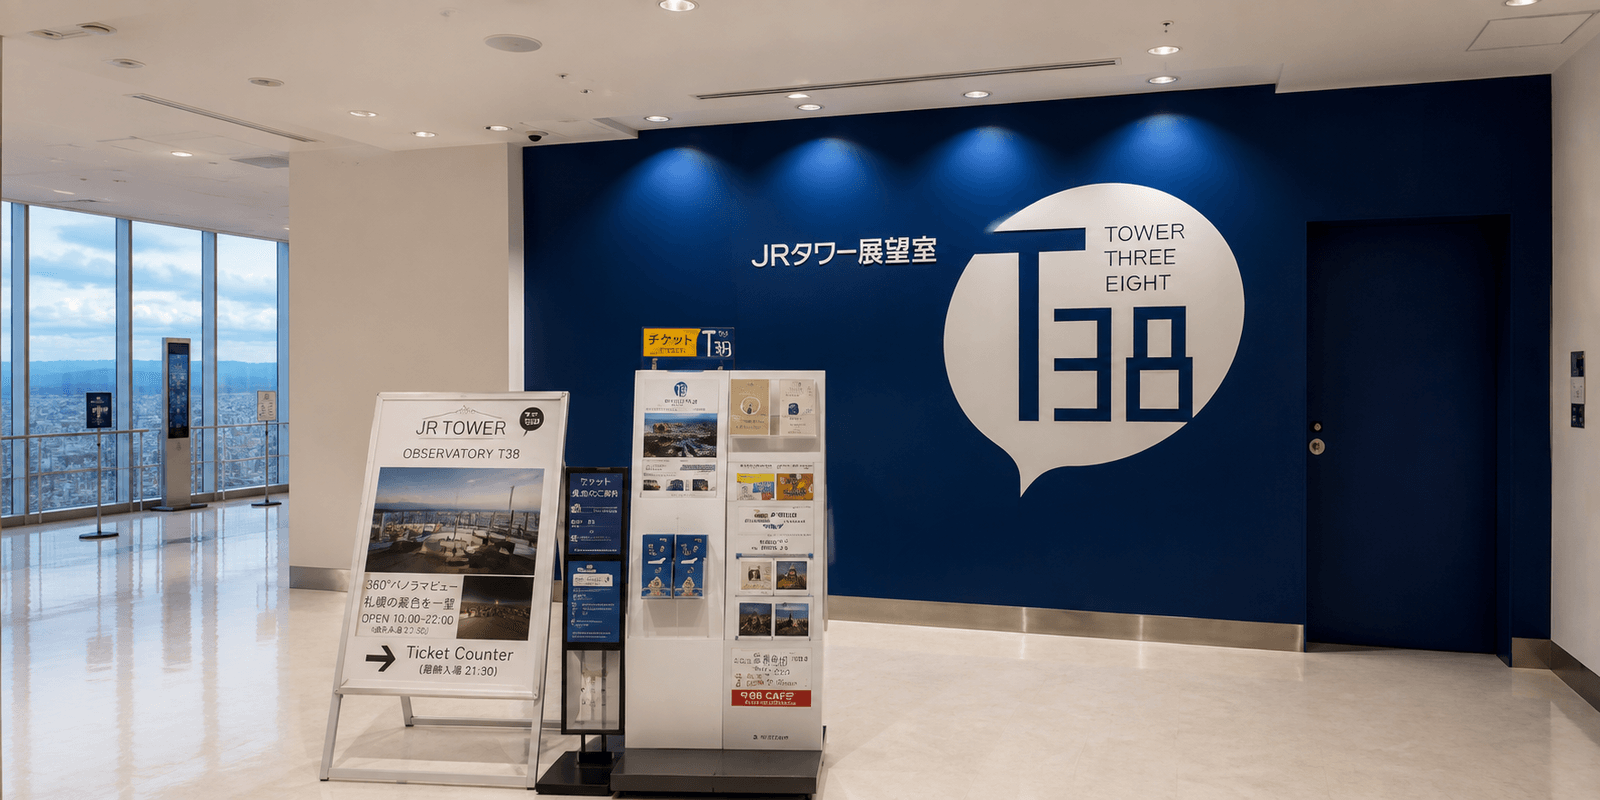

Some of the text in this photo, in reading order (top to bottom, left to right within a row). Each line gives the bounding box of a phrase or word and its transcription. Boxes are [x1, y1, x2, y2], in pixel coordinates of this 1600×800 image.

[1104, 223, 1185, 242] TOWER
[751, 235, 937, 267] JRタワー展望室
[1104, 248, 1176, 266] THREE
[1106, 274, 1171, 292] EIGHT
[975, 227, 1194, 423] T38
[648, 333, 692, 346] チケット
[416, 420, 507, 436] JR TOWER
[403, 448, 520, 459] OBSERVATORY T38
[362, 613, 390, 624] OPEN
[407, 645, 514, 661] Ticket Counter
